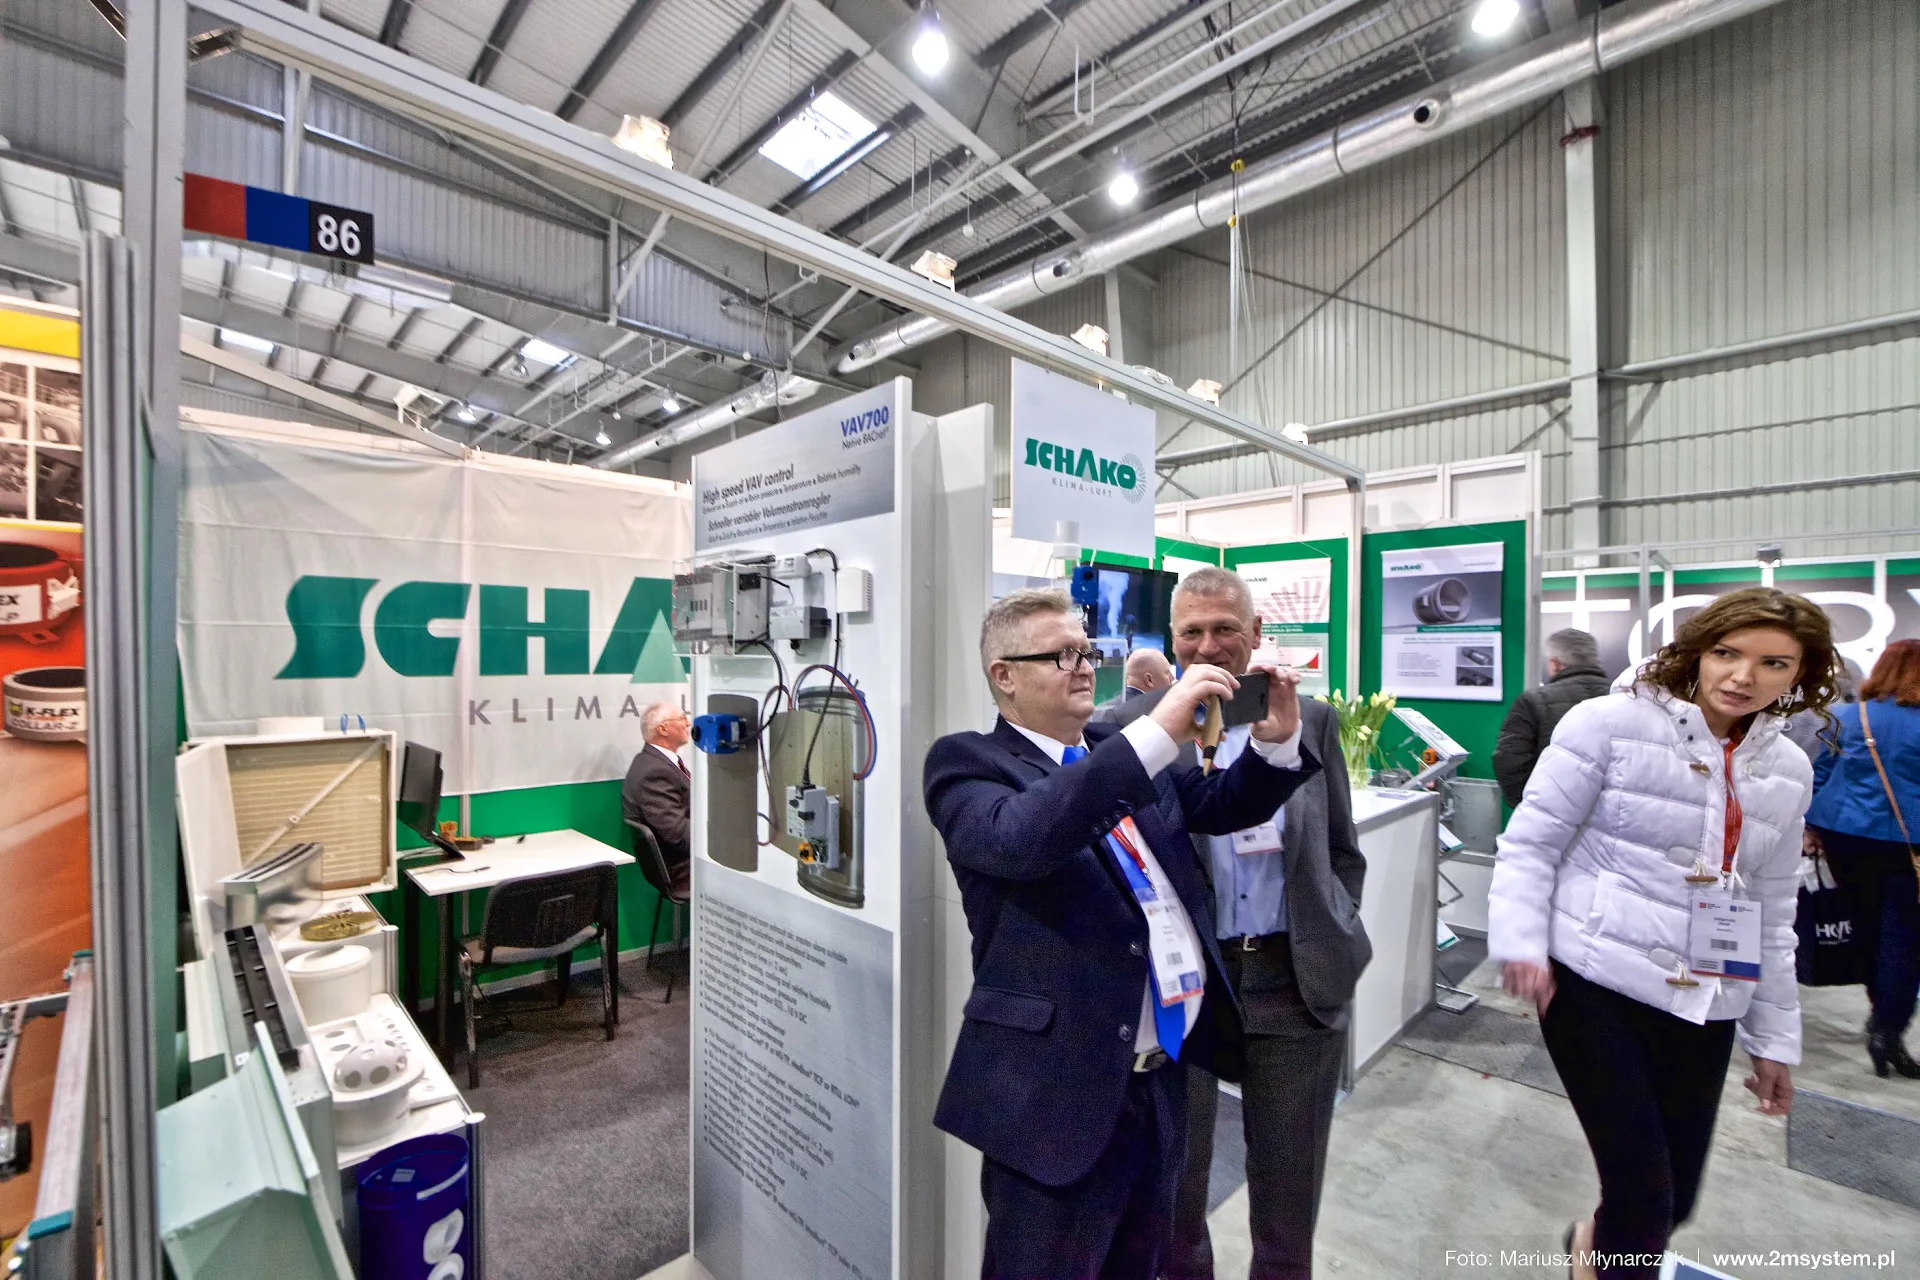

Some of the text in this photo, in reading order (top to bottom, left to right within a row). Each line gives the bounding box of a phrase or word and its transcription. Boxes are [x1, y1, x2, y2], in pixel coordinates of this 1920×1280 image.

[317, 214, 361, 256] 86
[841, 406, 889, 437] VAV700
[1025, 437, 1136, 490] SCHAKO
[703, 463, 794, 505] High speed VAV control
[1052, 477, 1112, 498] KLIMA-LUFT
[27, 707, 79, 717] K-FLEX
